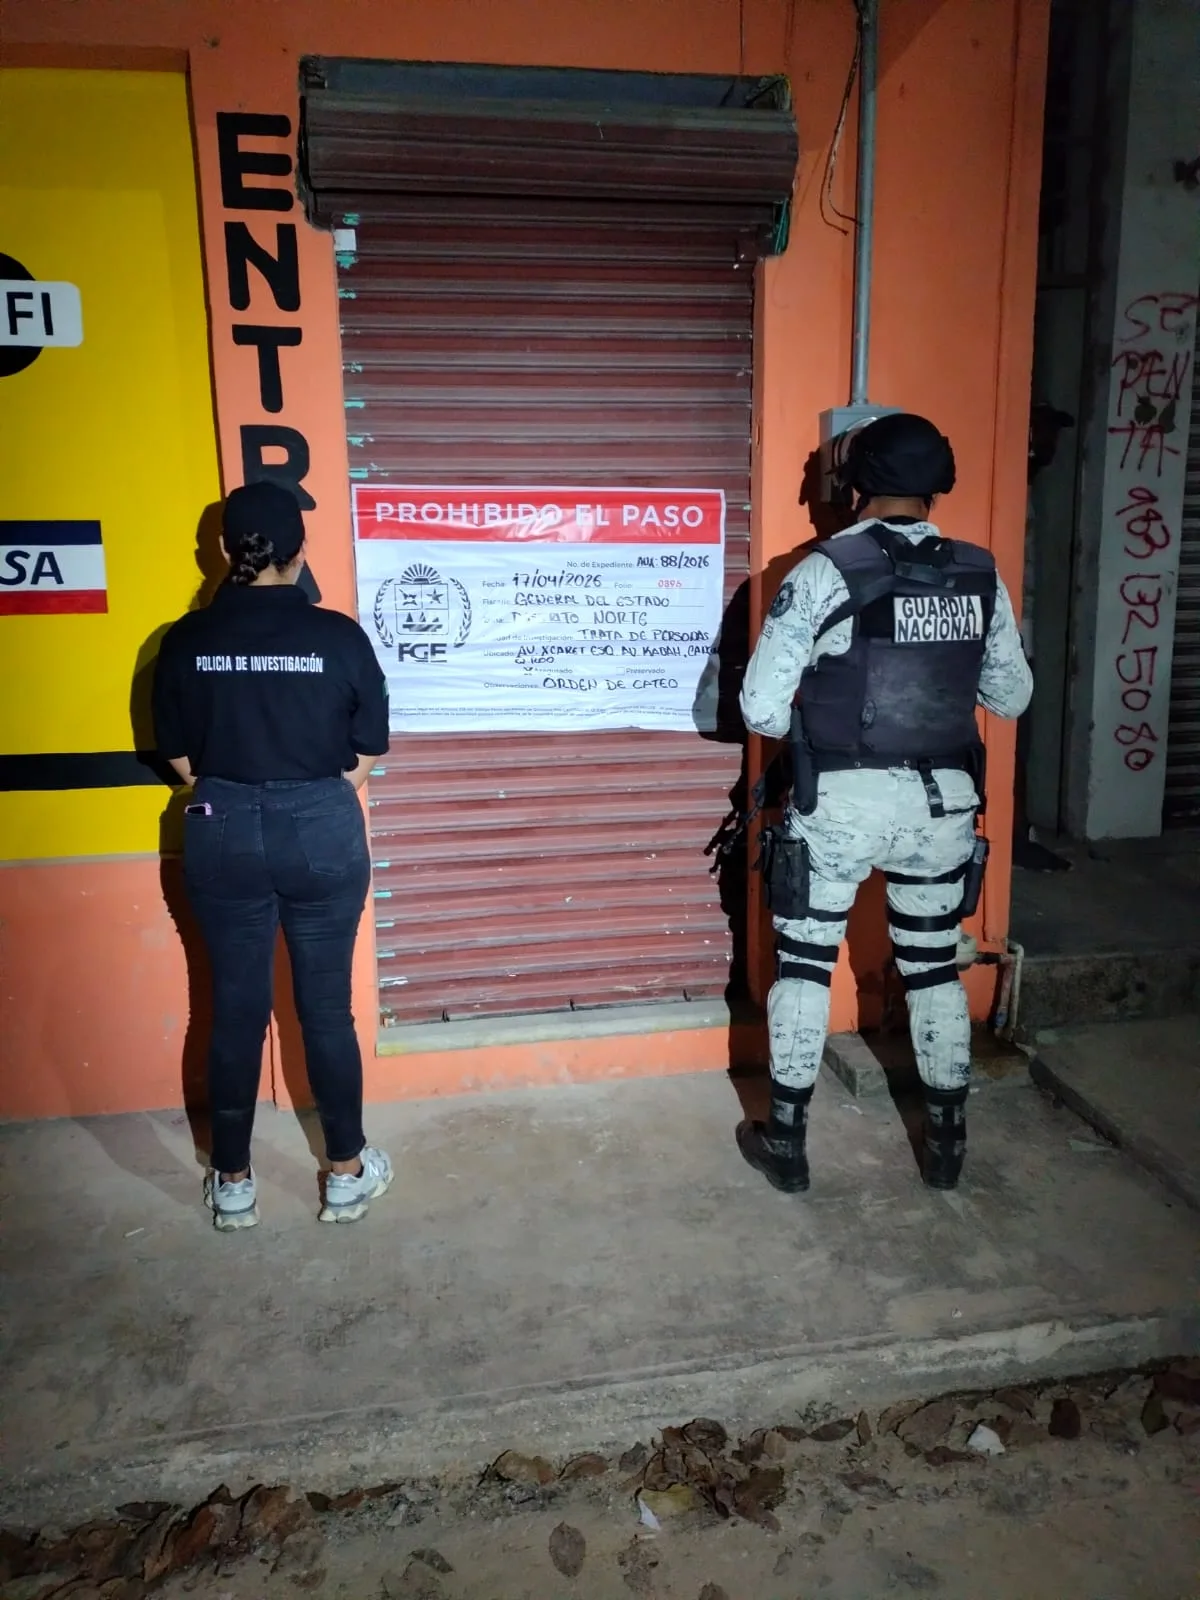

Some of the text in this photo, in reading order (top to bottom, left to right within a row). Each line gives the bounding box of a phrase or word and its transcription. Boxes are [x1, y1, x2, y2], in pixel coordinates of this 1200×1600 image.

[217, 112, 322, 604] ENTR
[375, 501, 704, 528] PROHIBIDO EL PASO
[585, 594, 610, 607] DEL
[616, 595, 670, 608] ESTADO
[902, 597, 976, 619] GUARDIA
[594, 610, 648, 627] NORTE
[577, 628, 710, 642] TRATA DE PERSONAS
[898, 618, 981, 641] NACIONAL
[196, 652, 323, 673] POLICIA DE INVESTIGACIÓN
[398, 642, 447, 663] FGE
[543, 677, 598, 692] ORDEN
[605, 679, 626, 691] DE
[632, 679, 679, 690] CATEO
